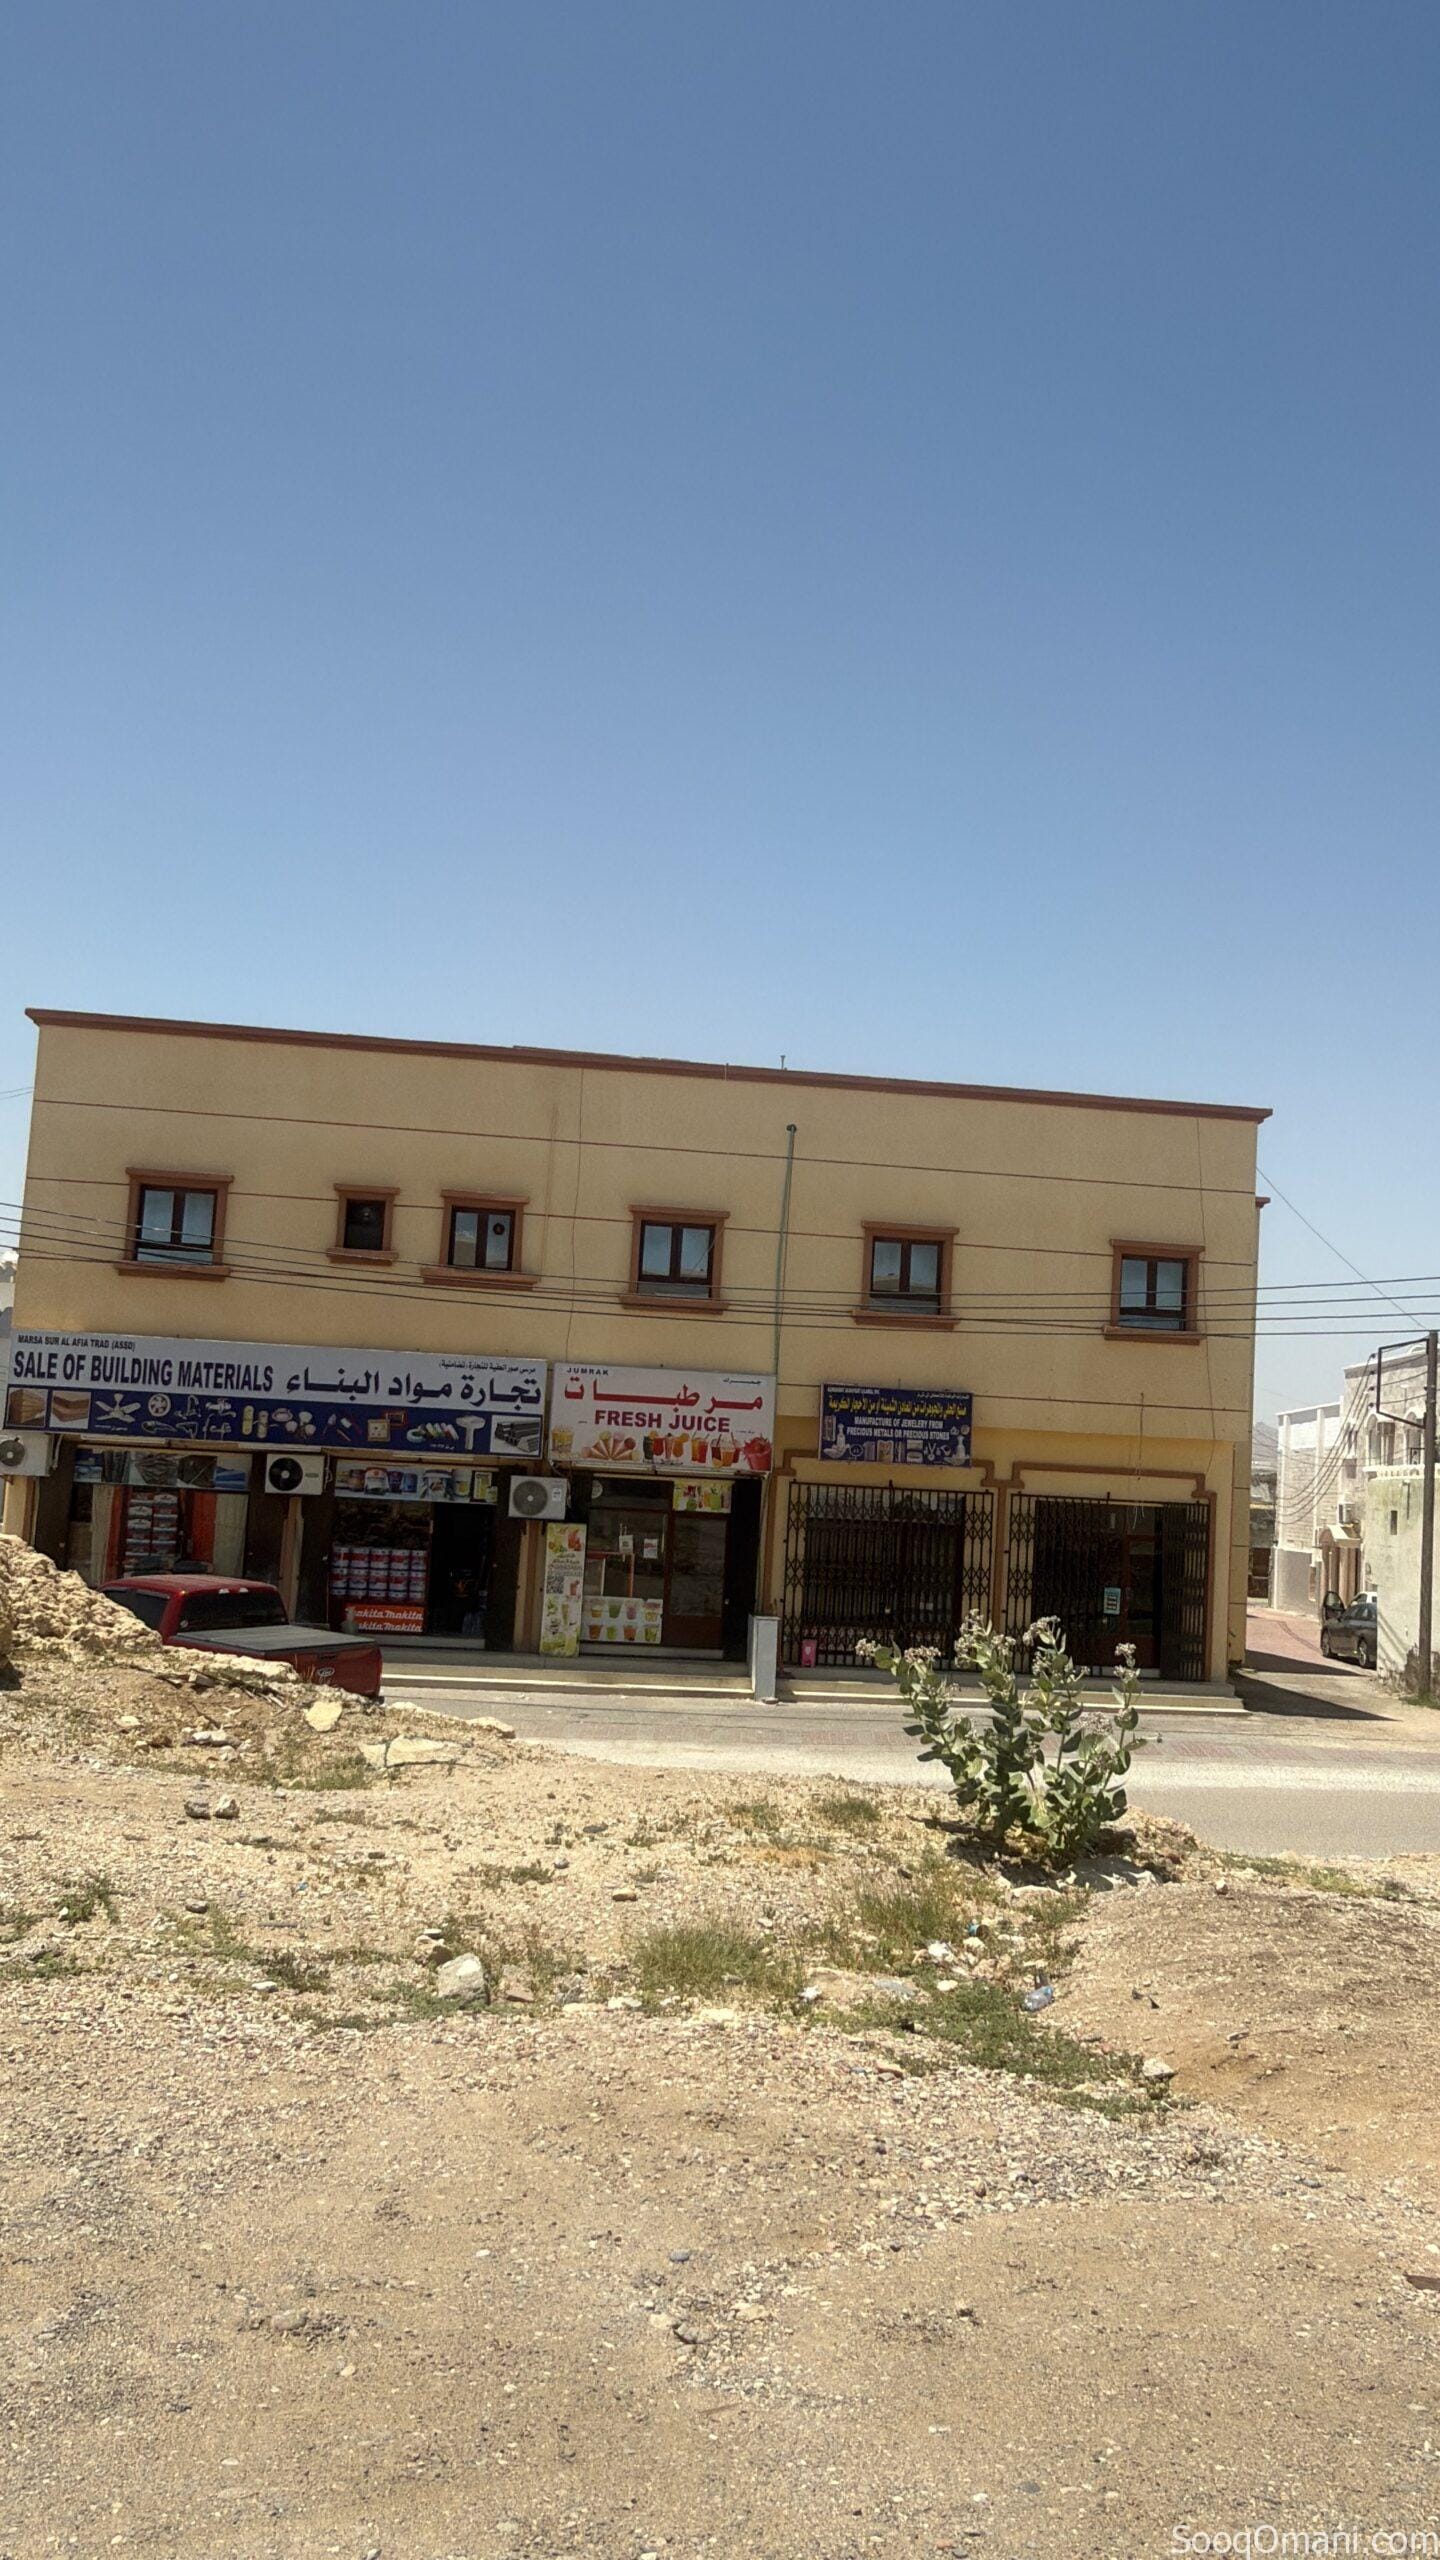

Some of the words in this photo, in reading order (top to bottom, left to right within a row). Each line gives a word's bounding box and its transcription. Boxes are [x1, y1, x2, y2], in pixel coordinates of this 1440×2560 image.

[17, 1335, 42, 1345] MARSA
[44, 1336, 60, 1346] SUR
[61, 1337, 70, 1347] AL
[72, 1338, 89, 1348] AFIA
[90, 1339, 110, 1349] TRAD
[13, 1350, 58, 1380] SALE
[63, 1353, 87, 1381] OF
[90, 1355, 173, 1387] BUILDING
[177, 1360, 274, 1392] MATERIALS
[286, 1366, 379, 1402] البناء
[566, 1367, 609, 1376] JUMRAK
[388, 1372, 453, 1405] مواد
[459, 1374, 542, 1411] تجارة
[564, 1376, 763, 1414] مرطبات
[594, 1409, 662, 1429] FRESH
[668, 1414, 731, 1433] JUICE
[846, 1426, 872, 1437] PRECIOUS
[873, 1428, 894, 1438] METALS
[894, 1428, 902, 1439] OR
[902, 1429, 929, 1440] PRECIOUS
[929, 1431, 950, 1440] STONES
[854, 1416, 892, 1427] MANUFACTURE
[893, 1418, 901, 1428] OF
[929, 1420, 944, 1430] FROM
